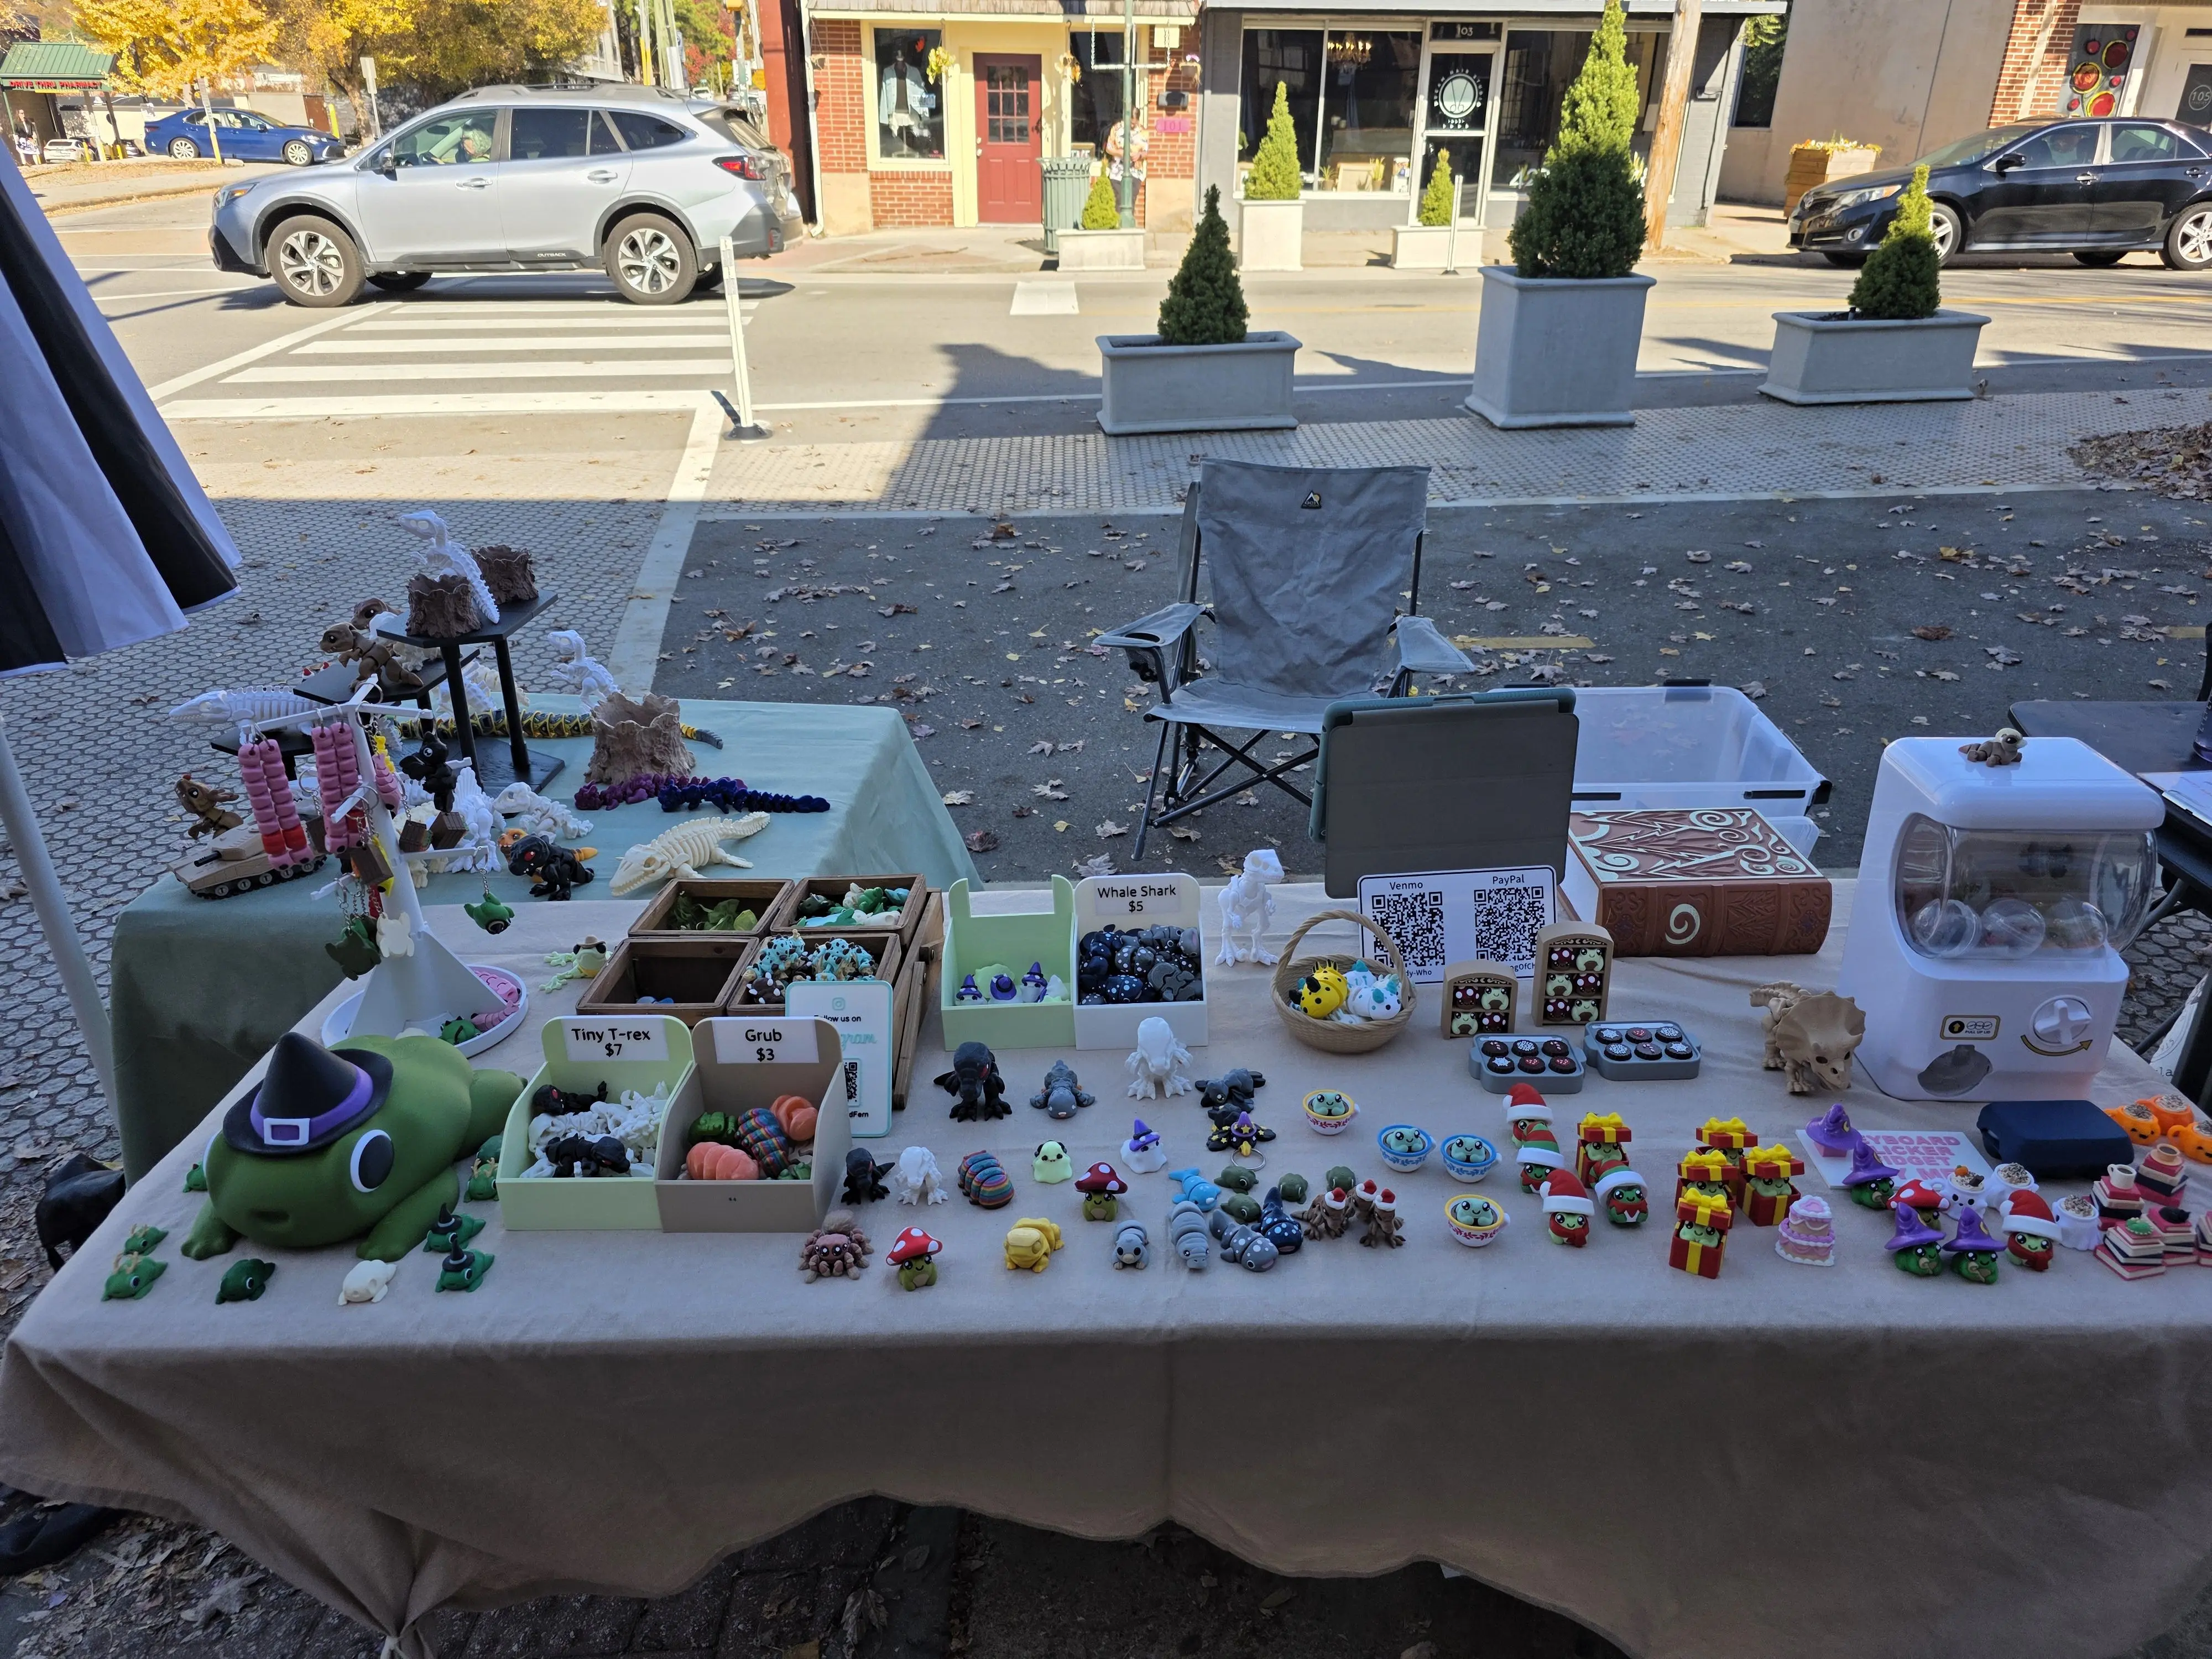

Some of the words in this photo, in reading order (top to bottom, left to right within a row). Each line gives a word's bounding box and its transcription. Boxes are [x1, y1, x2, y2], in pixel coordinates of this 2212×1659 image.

[2192, 91, 2210, 101] 105
[1164, 121, 1182, 131] 101
[1390, 881, 1423, 890] Venmo
[1493, 874, 1525, 885] PayPal
[1097, 886, 1137, 898] Whale
[1140, 884, 1176, 897] Shark
[1129, 900, 1143, 913] $5
[571, 1028, 604, 1043] Tiny
[608, 1028, 651, 1041] T-rex
[745, 1029, 782, 1042] Grub
[604, 1042, 622, 1057] $7
[756, 1047, 775, 1062] $3
[1871, 1145, 1956, 1156] LICKER
[1882, 1155, 1951, 1166] IDGET
